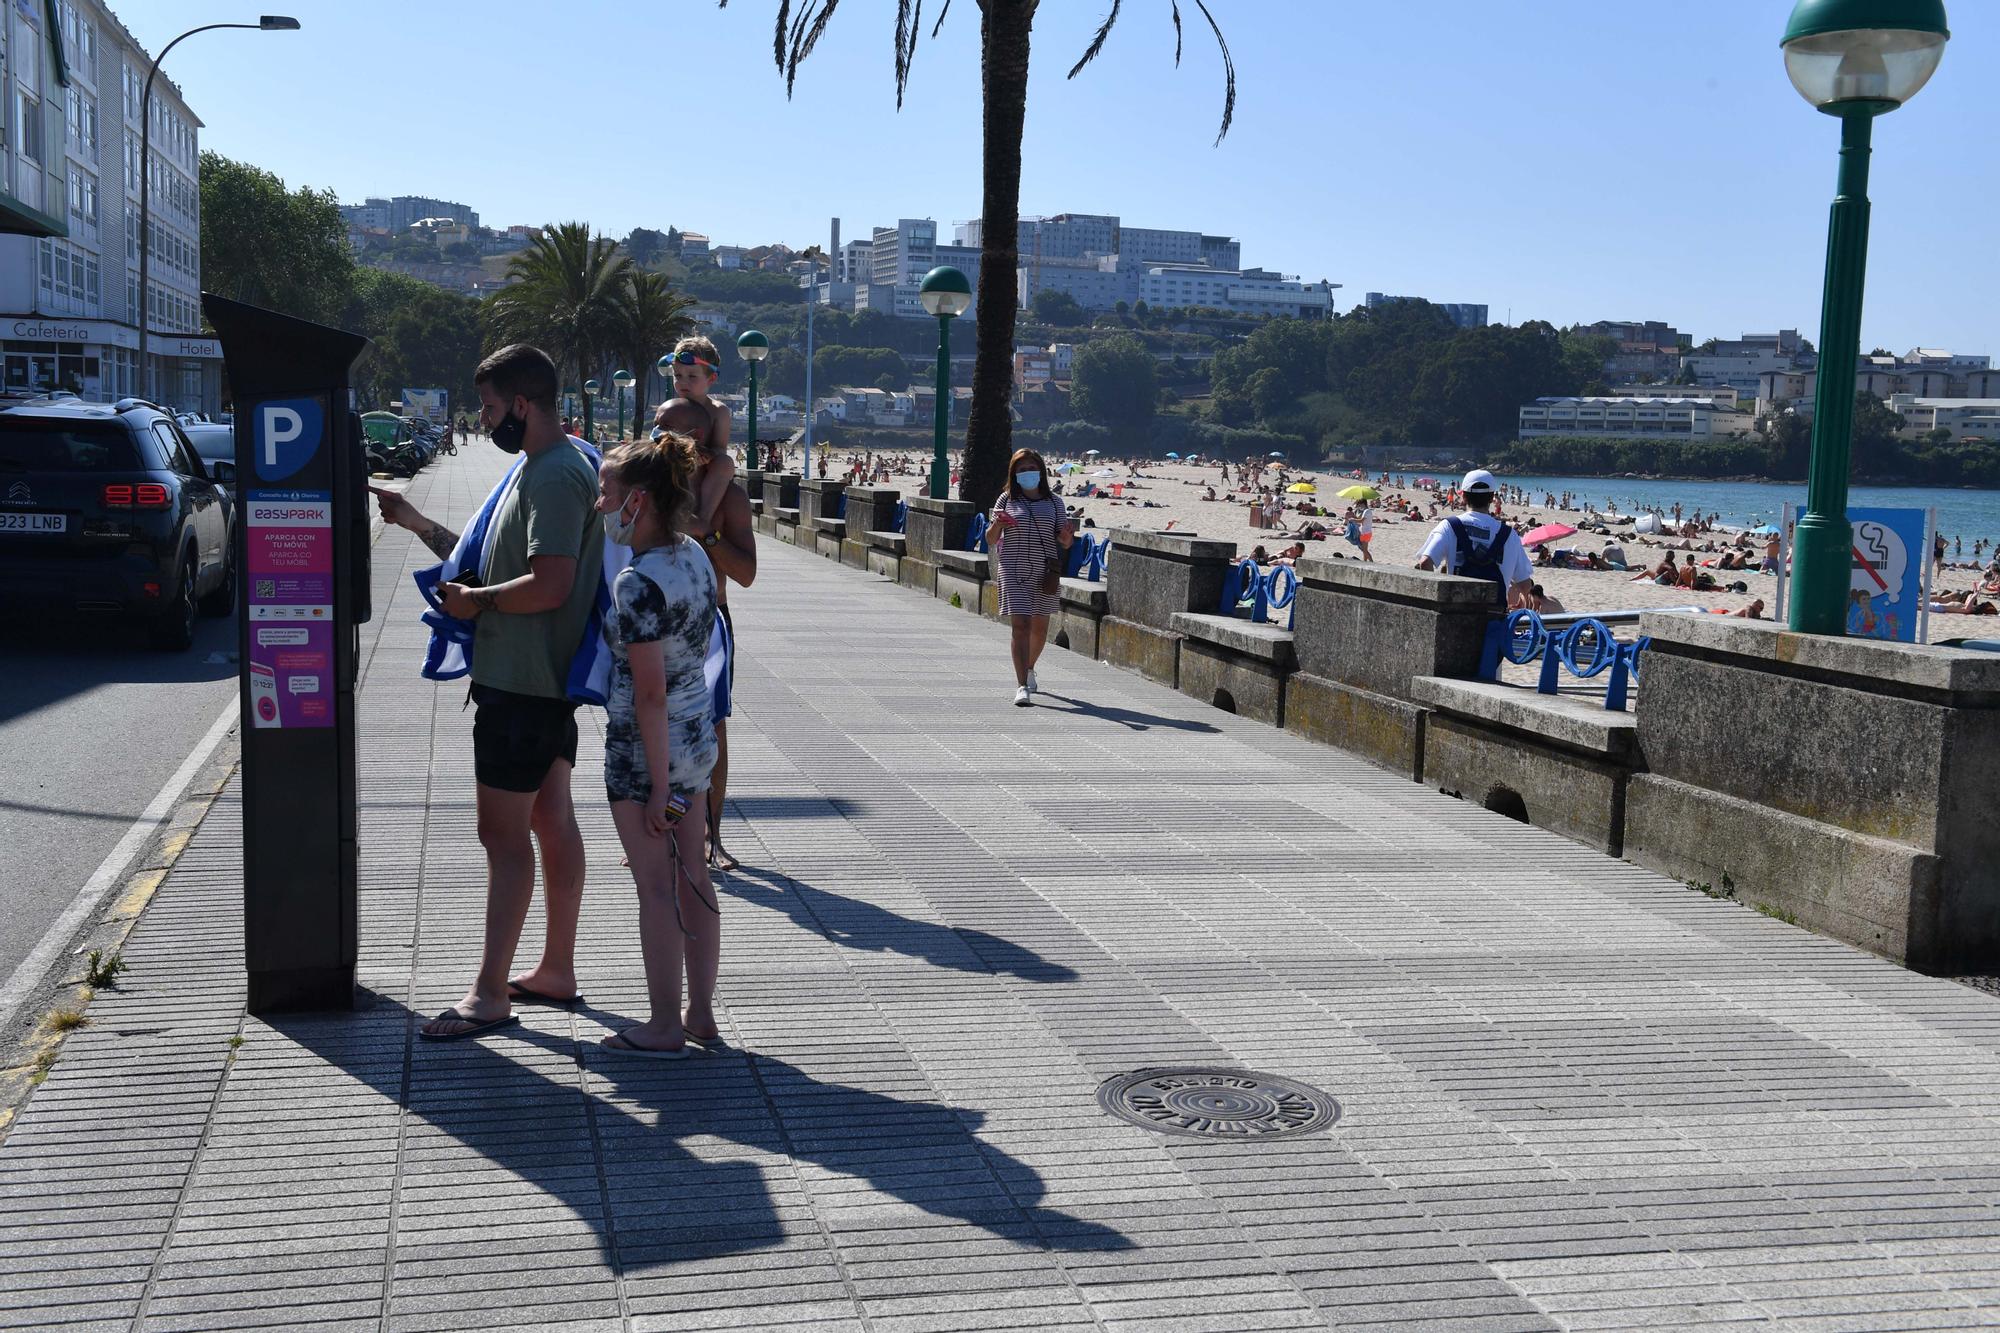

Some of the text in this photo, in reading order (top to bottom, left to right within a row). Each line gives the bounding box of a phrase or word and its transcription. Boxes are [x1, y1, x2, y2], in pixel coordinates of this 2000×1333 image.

[13, 322, 88, 340] Cafetería
[180, 342, 215, 355] Hotel
[263, 406, 303, 465] P
[32, 517, 62, 530] LNB
